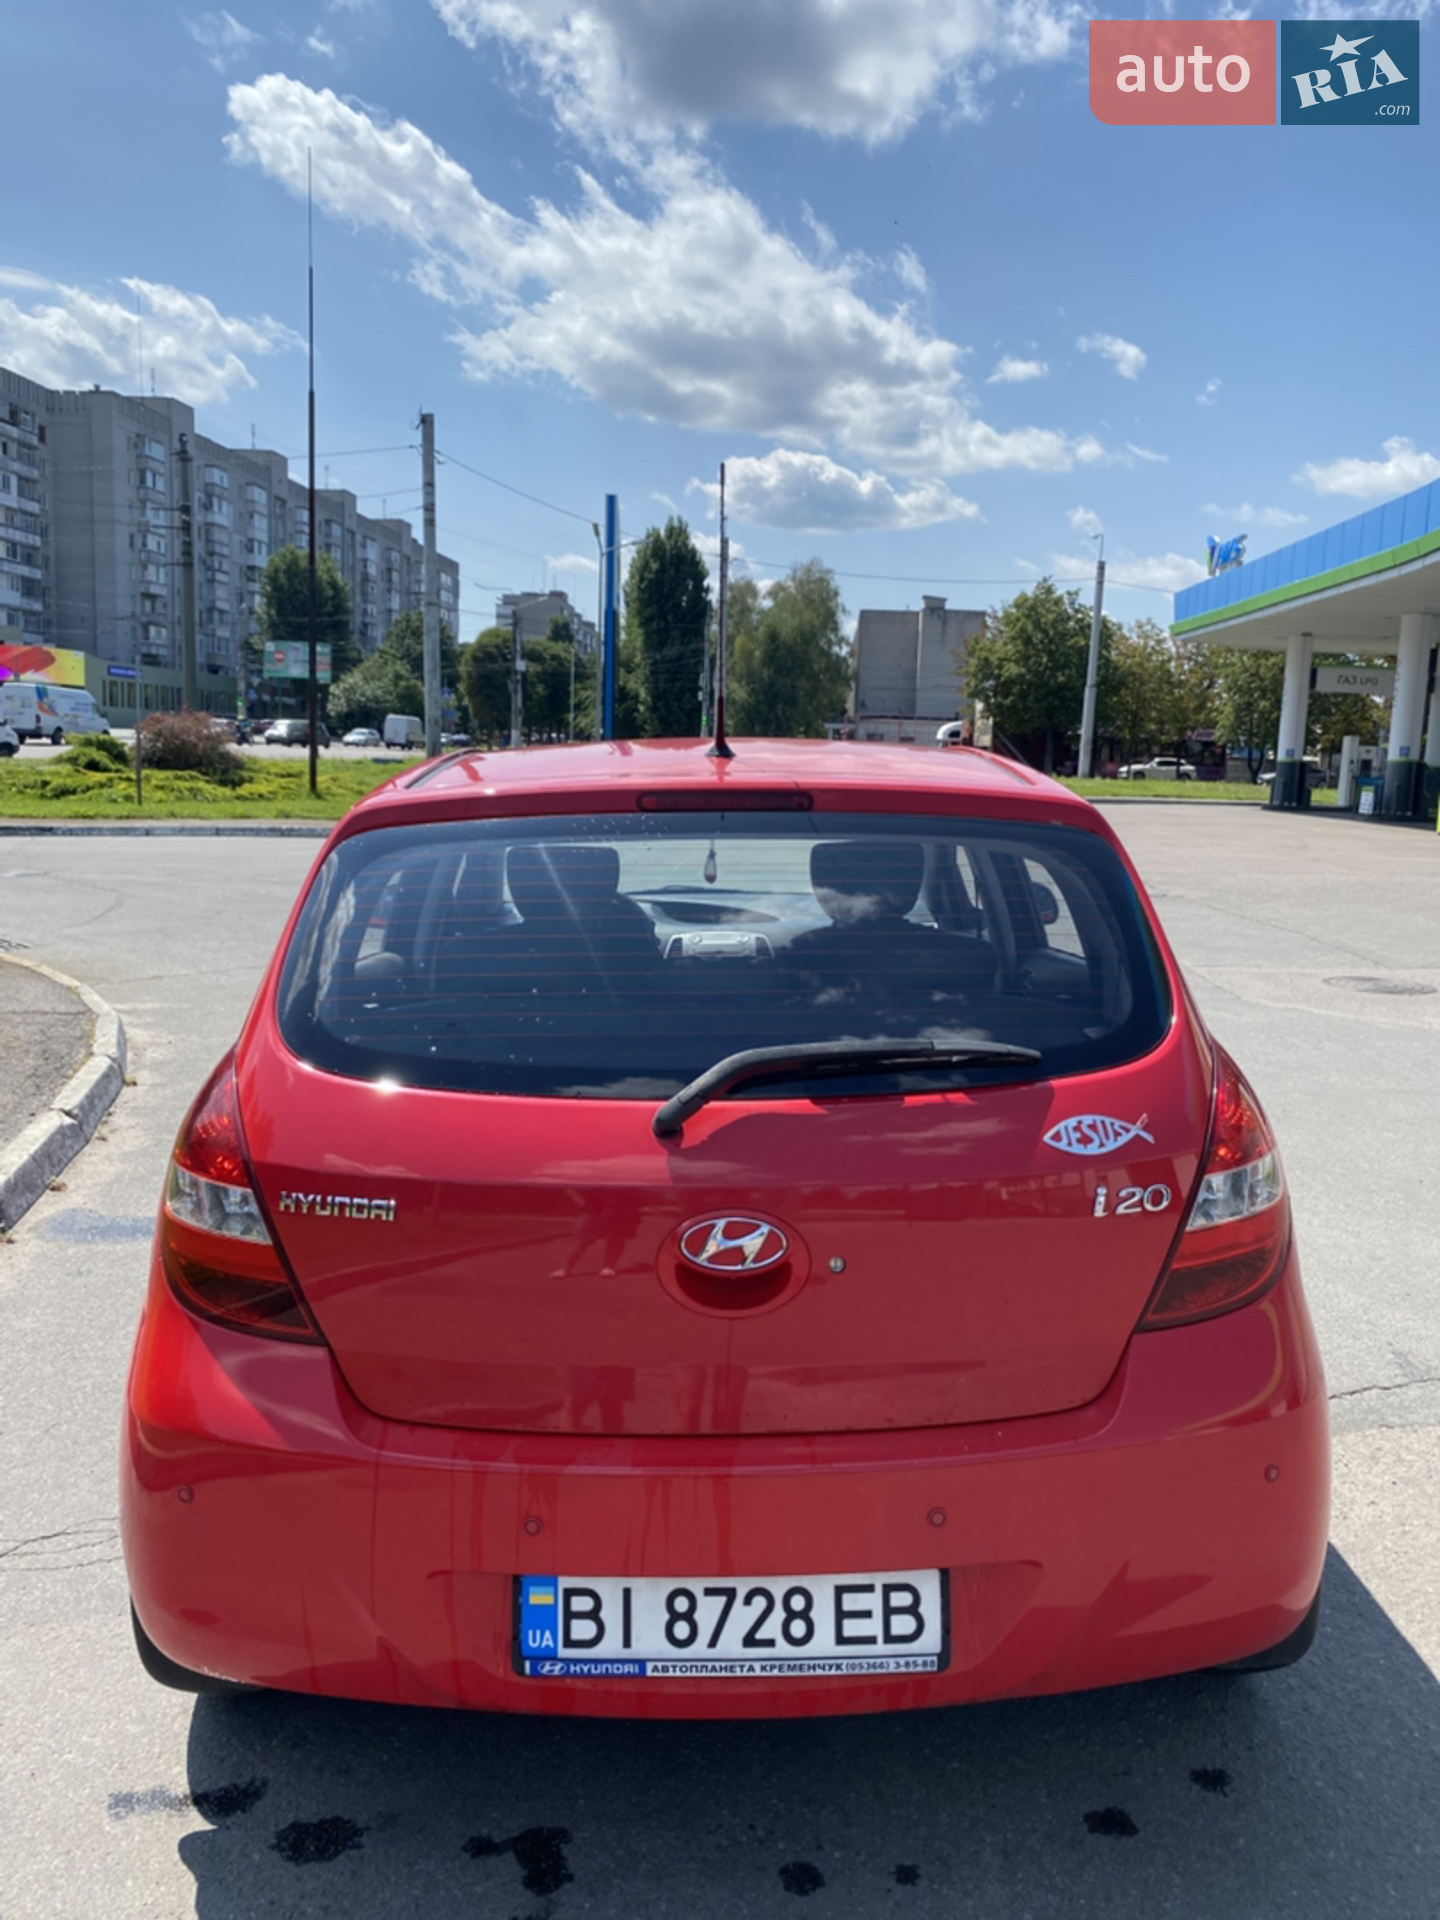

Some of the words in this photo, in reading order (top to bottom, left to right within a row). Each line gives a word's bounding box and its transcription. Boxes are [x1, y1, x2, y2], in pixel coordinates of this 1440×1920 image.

[1337, 674, 1357, 686] ГАЗ
[1050, 1117, 1127, 1150] JESUS
[279, 1190, 396, 1222] HYUNDAI
[562, 1587, 633, 1649] BI
[664, 1585, 815, 1649] 8728
[833, 1582, 926, 1646] EB
[528, 1629, 555, 1648] UA
[569, 1662, 640, 1674] HYUNDAI
[651, 1663, 757, 1674] АВТОПЛАНЕТА
[760, 1661, 844, 1674] КРЕМЕНЧУК
